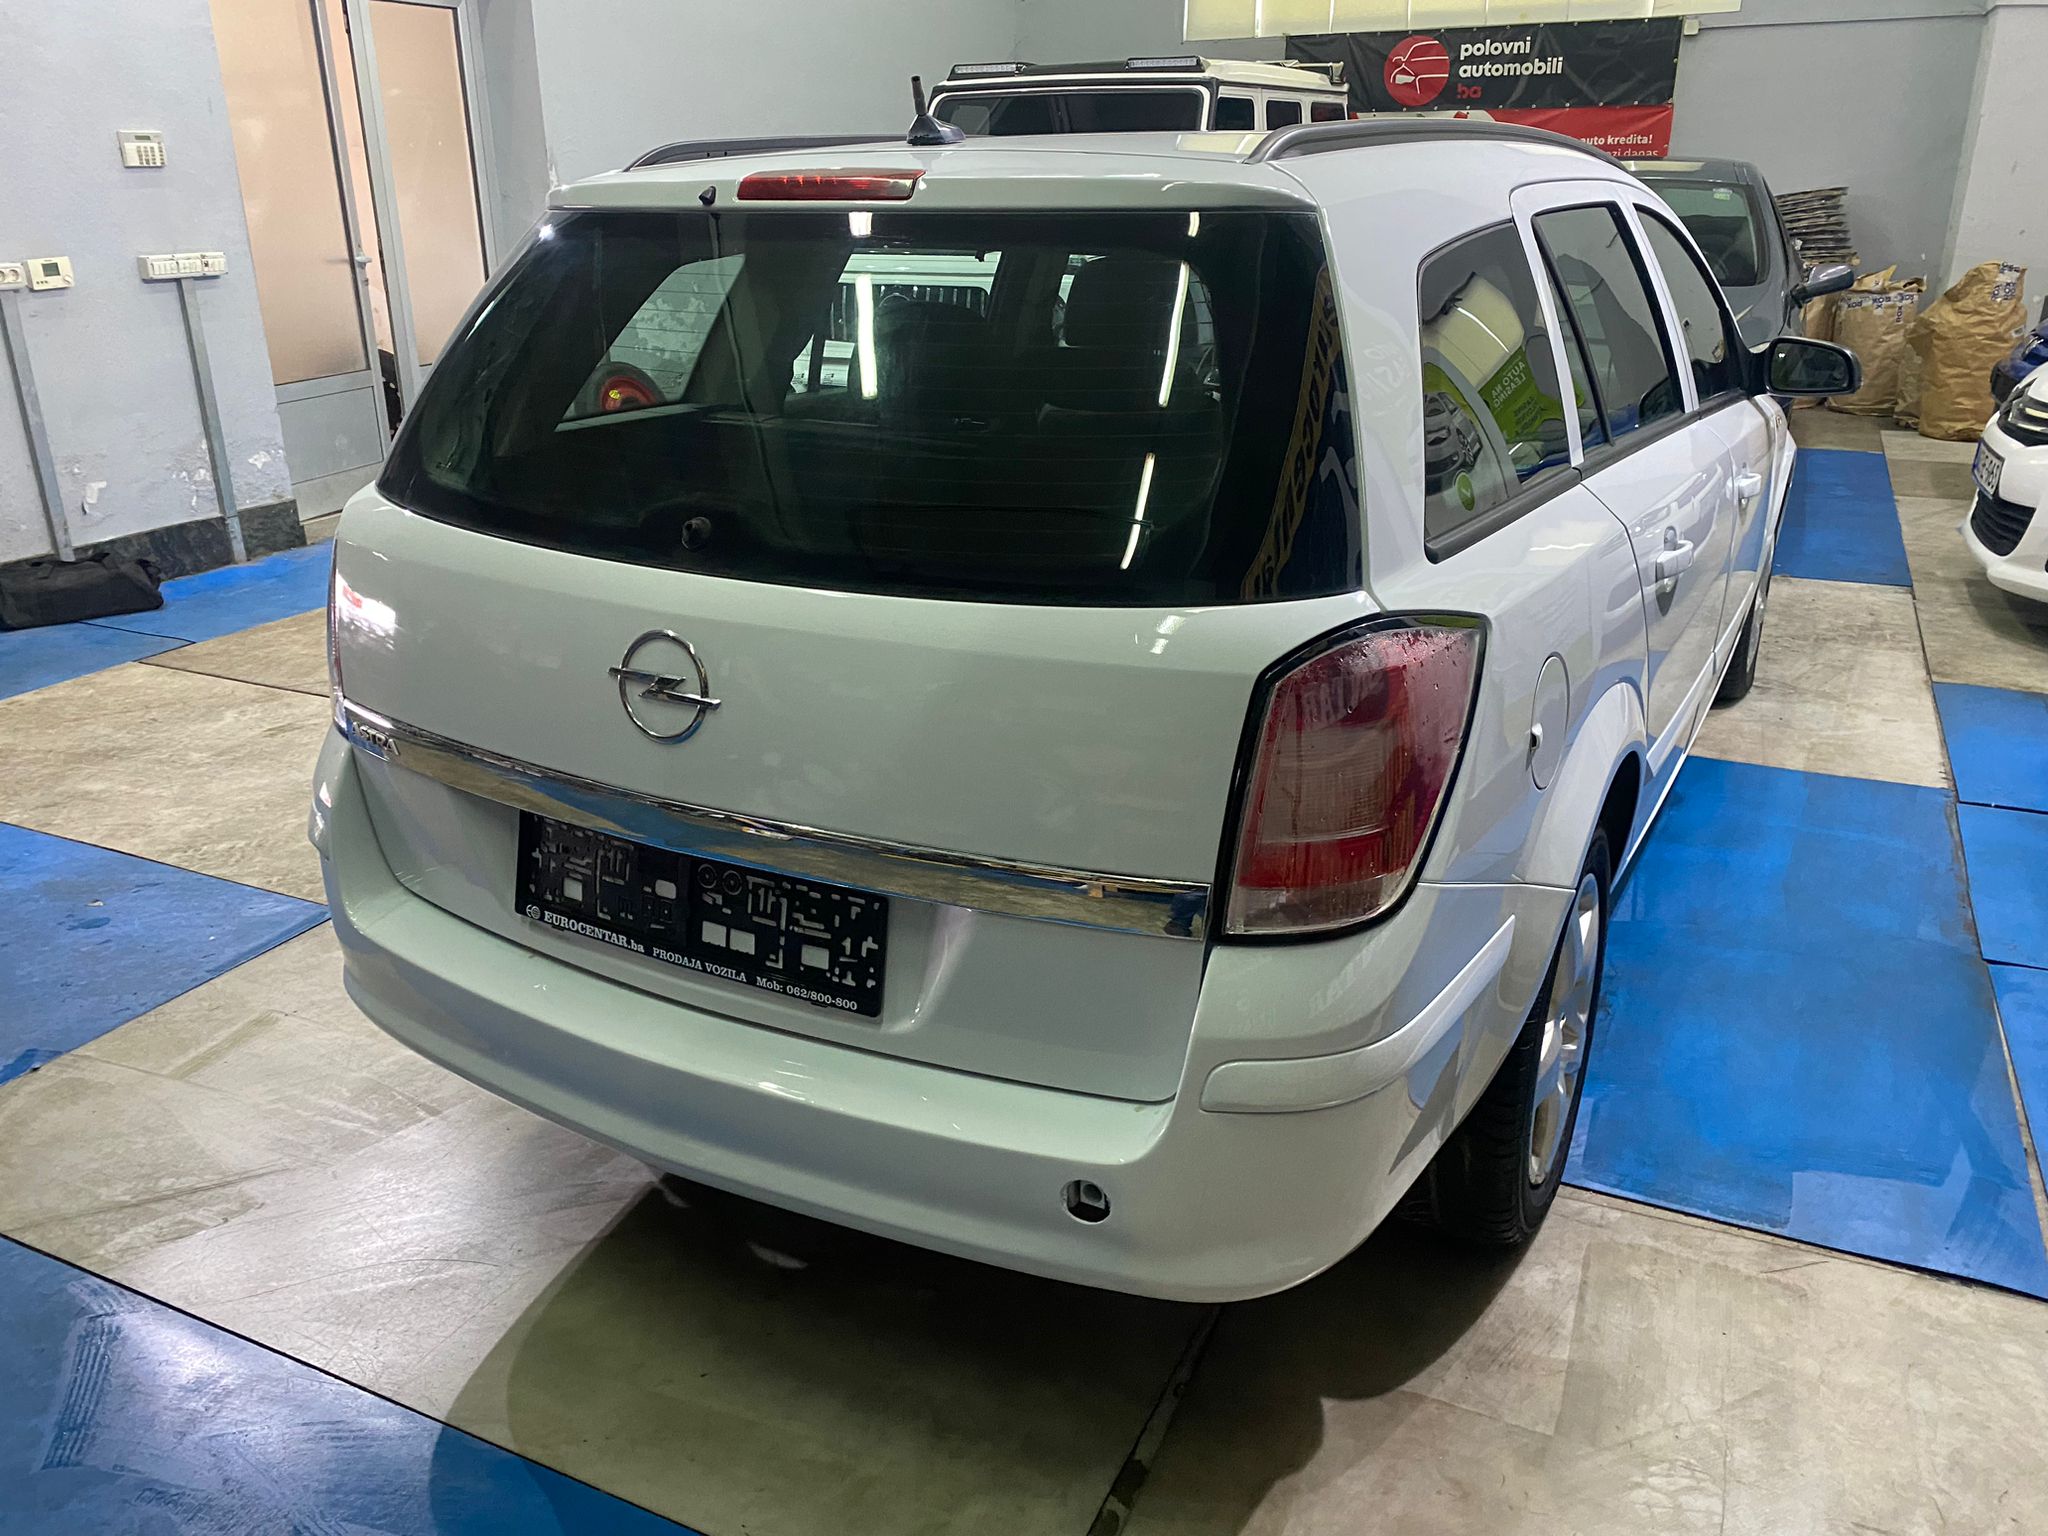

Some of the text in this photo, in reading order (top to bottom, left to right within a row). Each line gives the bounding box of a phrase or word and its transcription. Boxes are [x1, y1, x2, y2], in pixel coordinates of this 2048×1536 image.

[1459, 36, 1532, 61] polovni
[1458, 56, 1564, 78] automobili
[1581, 133, 1654, 145] auto kredita!
[543, 910, 858, 1011] EUROCENTAR.ba PRODAJA VOZILA Mob: 062/800-800
